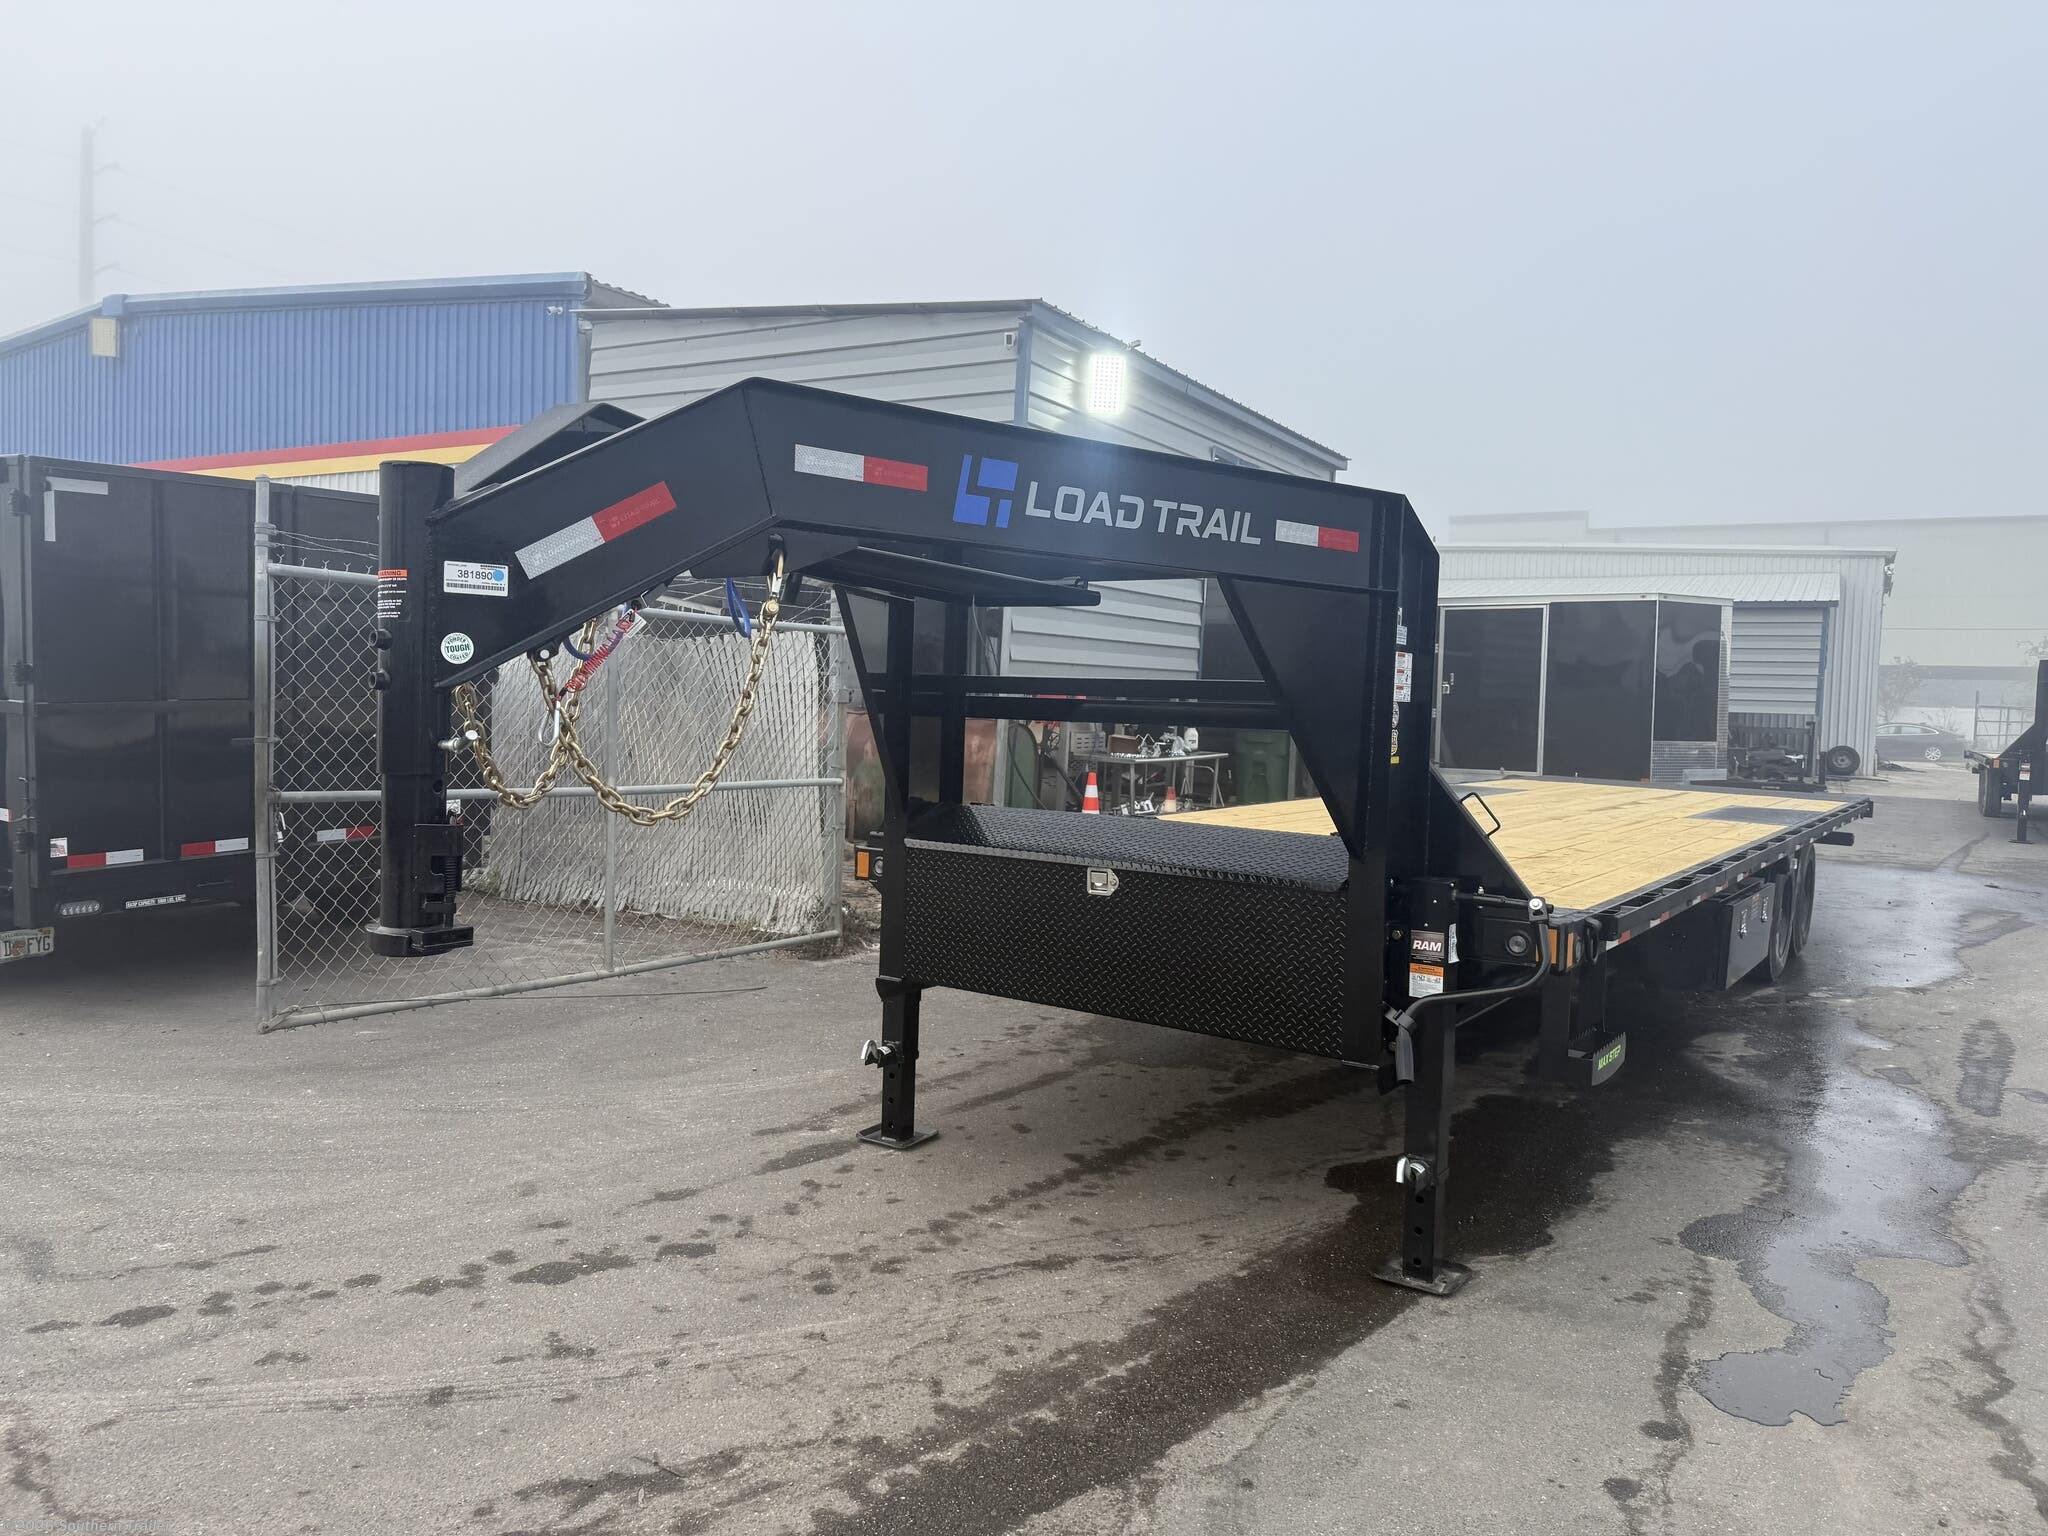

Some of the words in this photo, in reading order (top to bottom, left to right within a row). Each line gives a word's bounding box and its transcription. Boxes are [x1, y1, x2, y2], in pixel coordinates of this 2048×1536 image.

[1025, 481, 1145, 530] LOAD
[1153, 499, 1262, 545] TRAIL
[457, 569, 493, 581] 381890
[445, 643, 471, 654] TOUGH
[27, 935, 51, 953] FYG
[1412, 939, 1442, 952] RAM
